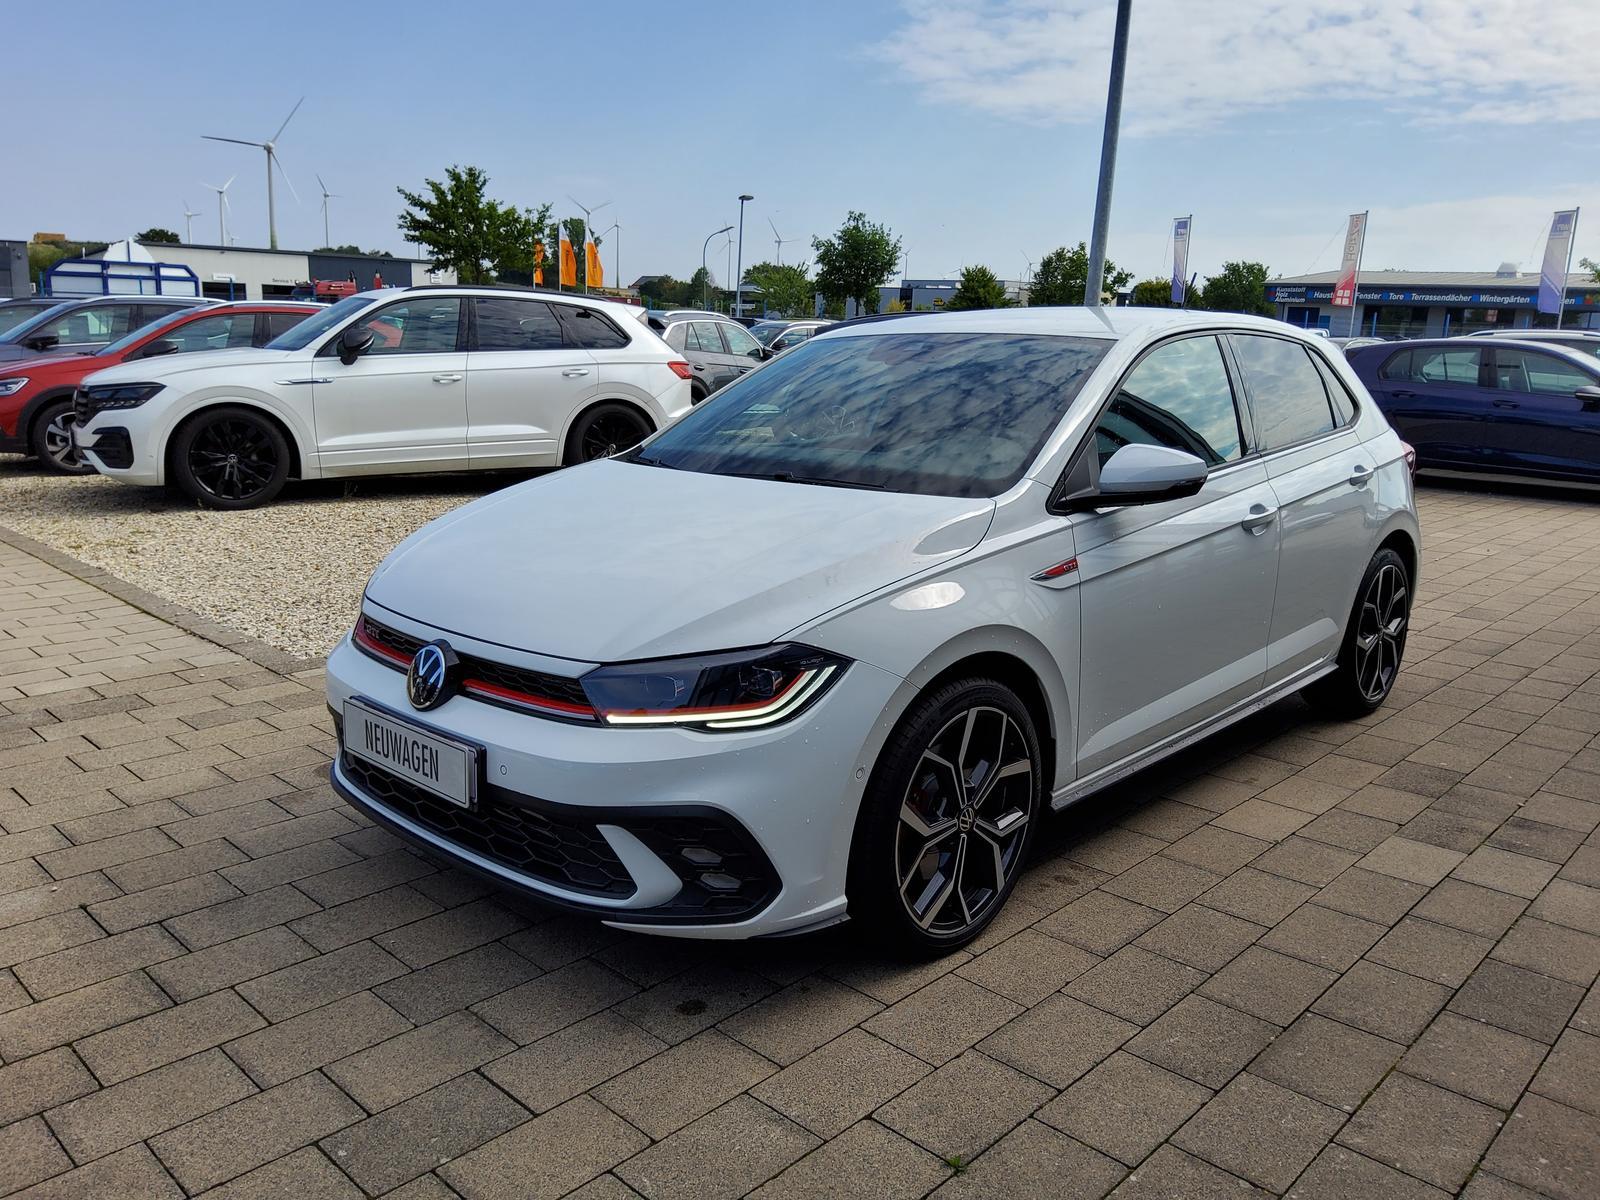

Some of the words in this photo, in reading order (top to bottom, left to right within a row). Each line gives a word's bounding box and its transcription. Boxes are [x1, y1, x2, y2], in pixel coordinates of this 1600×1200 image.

[1313, 291, 1335, 299] Haust
[1389, 292, 1404, 300] Tore
[1411, 293, 1472, 301] Terrassendächer
[1480, 294, 1530, 304] Wintergärten
[365, 719, 439, 782] NEUWAGEN
